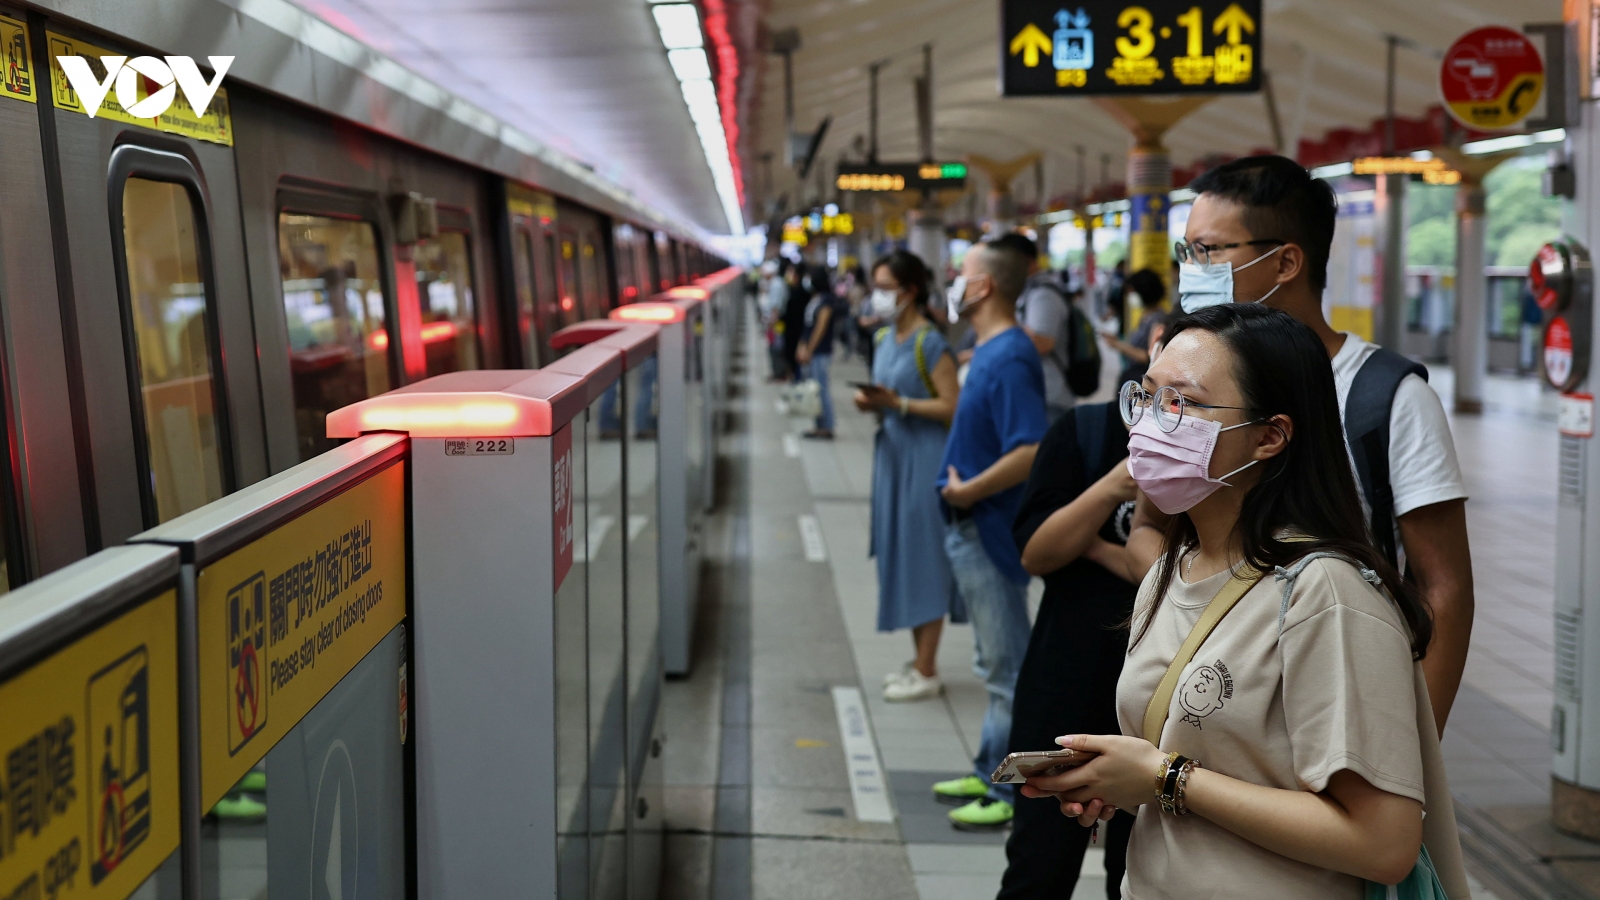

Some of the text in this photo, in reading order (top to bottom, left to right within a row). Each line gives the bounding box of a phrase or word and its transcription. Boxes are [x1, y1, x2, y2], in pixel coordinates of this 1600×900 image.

[476, 440, 507, 452] 222
[269, 519, 372, 648] 關門時勿強行進出
[270, 579, 383, 696] Please stay clear of closing doors
